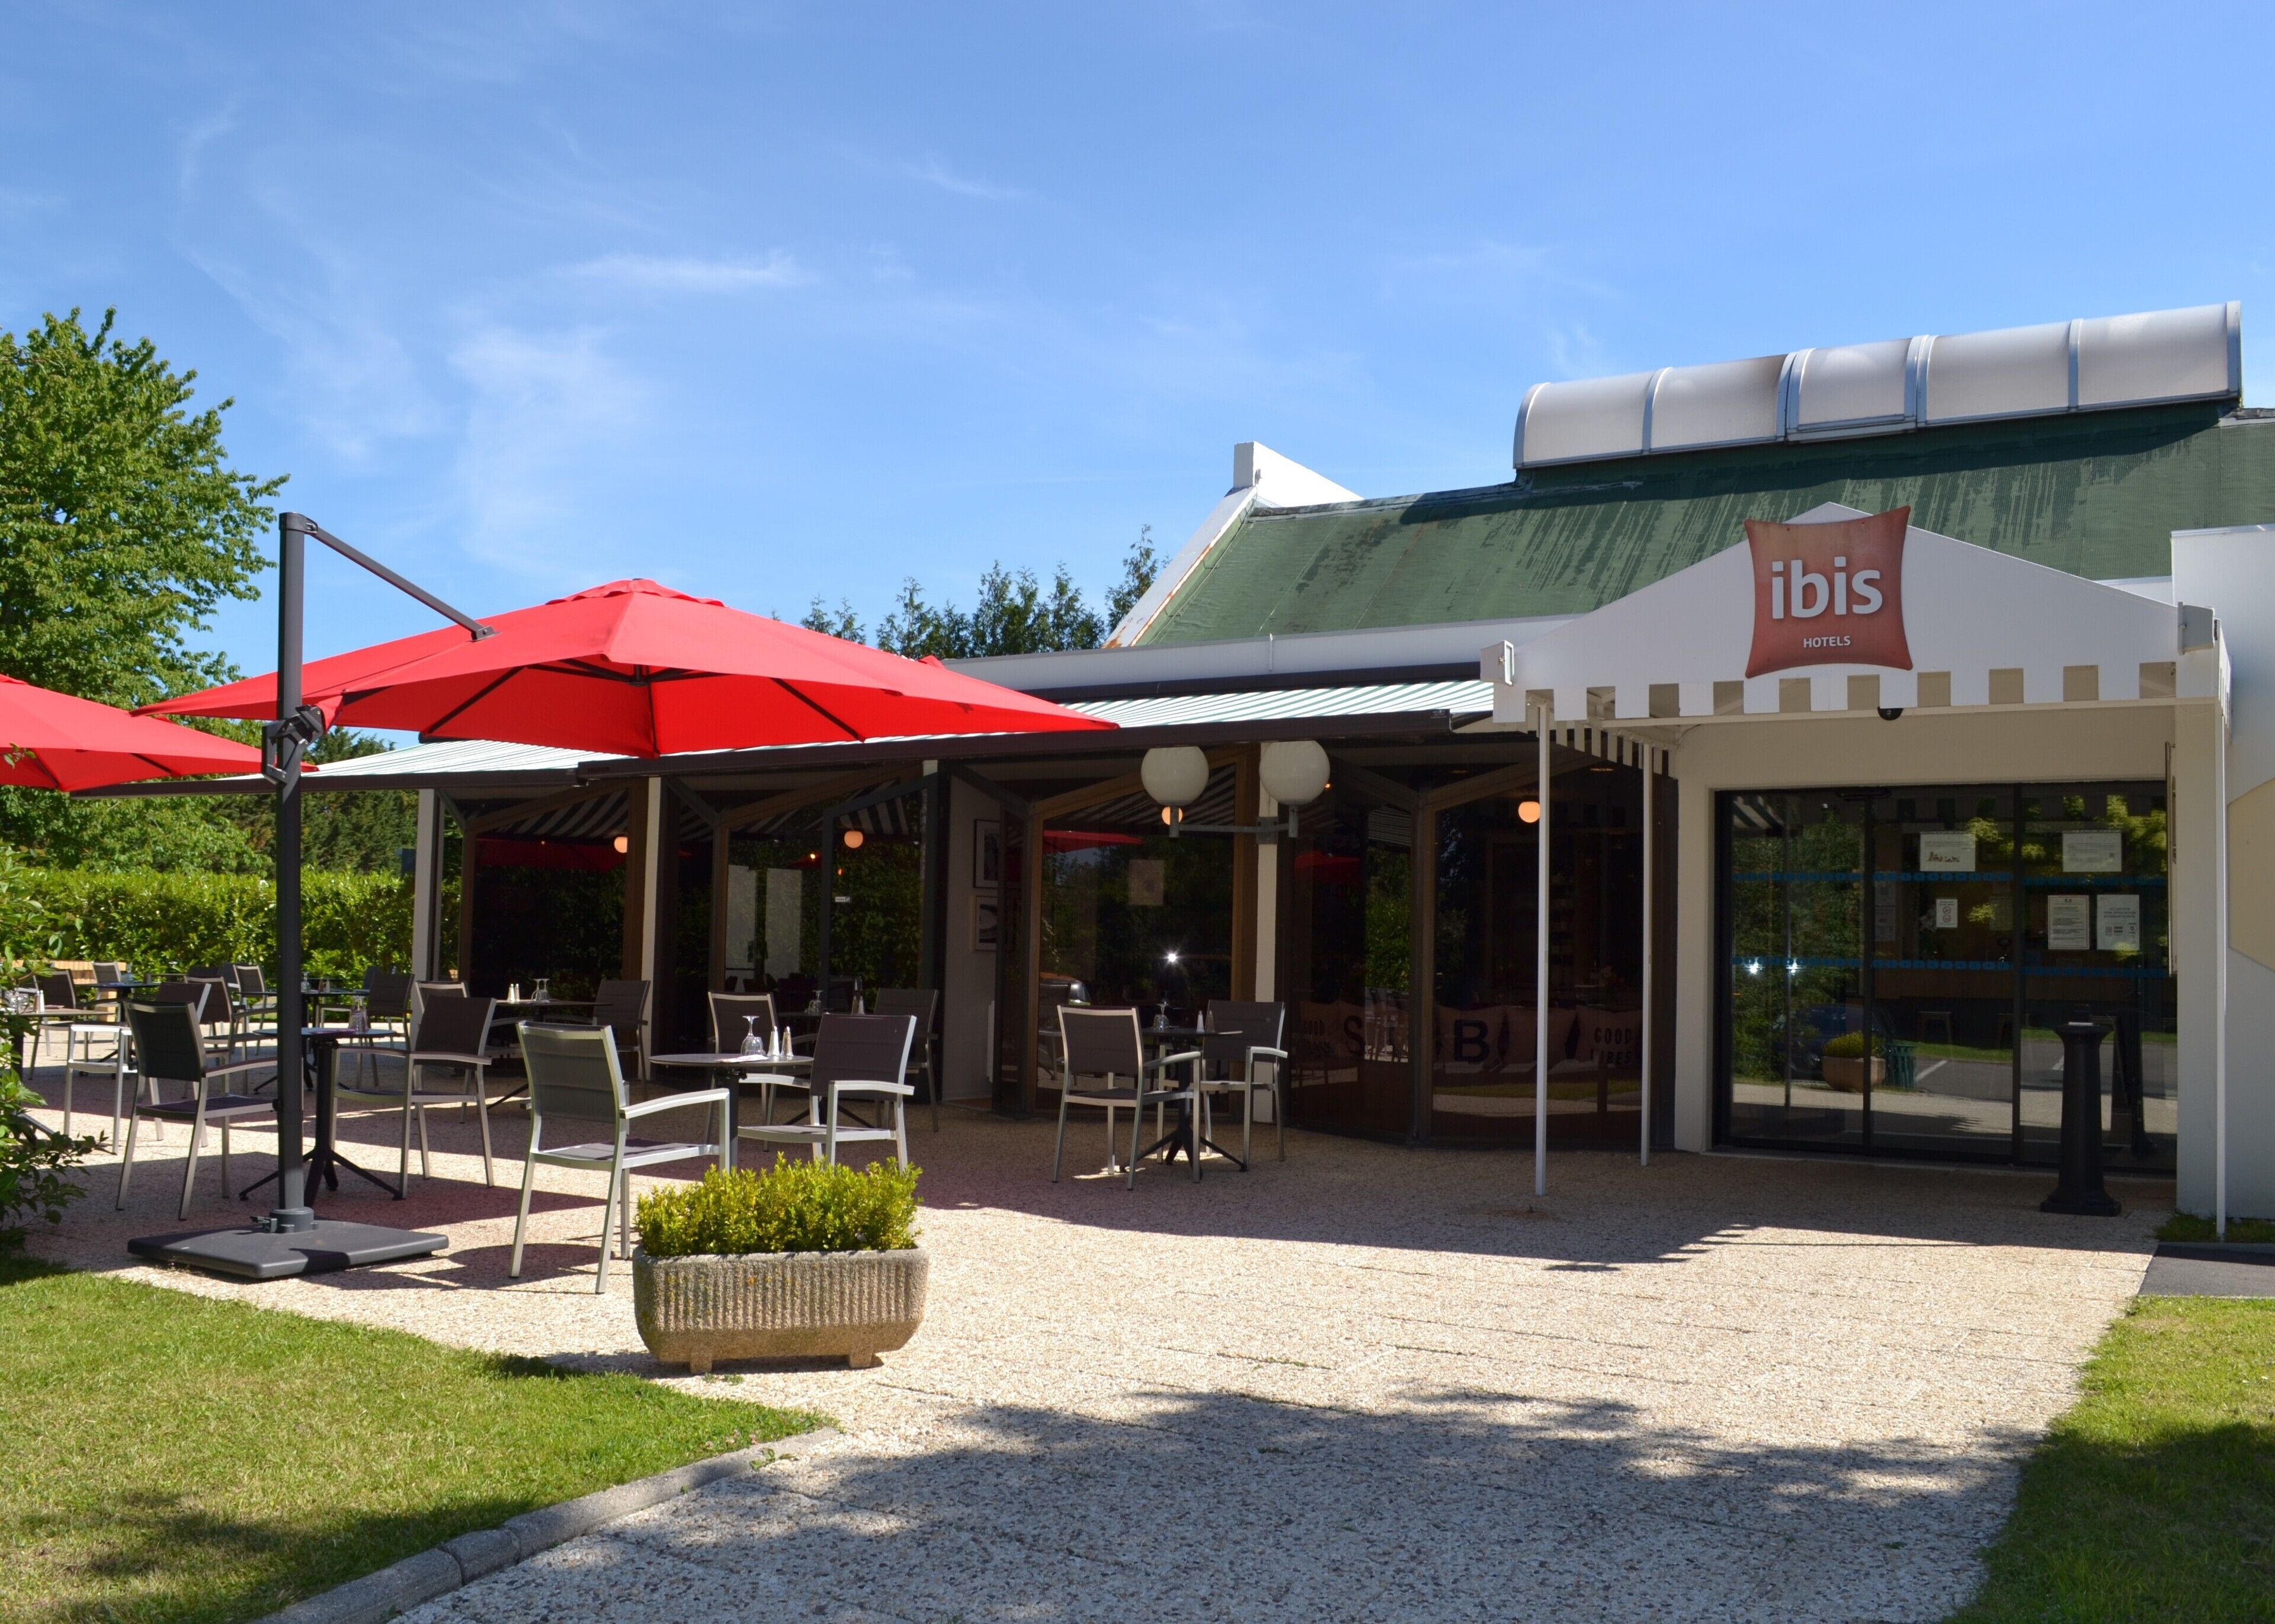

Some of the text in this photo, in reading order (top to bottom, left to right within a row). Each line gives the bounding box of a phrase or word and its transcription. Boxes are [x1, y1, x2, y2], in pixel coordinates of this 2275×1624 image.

[1772, 556, 1883, 619] ibis
[1803, 636, 1851, 648] HOTELS
[1454, 1019, 1490, 1062] B
[1594, 1028, 1632, 1044] GOOD
